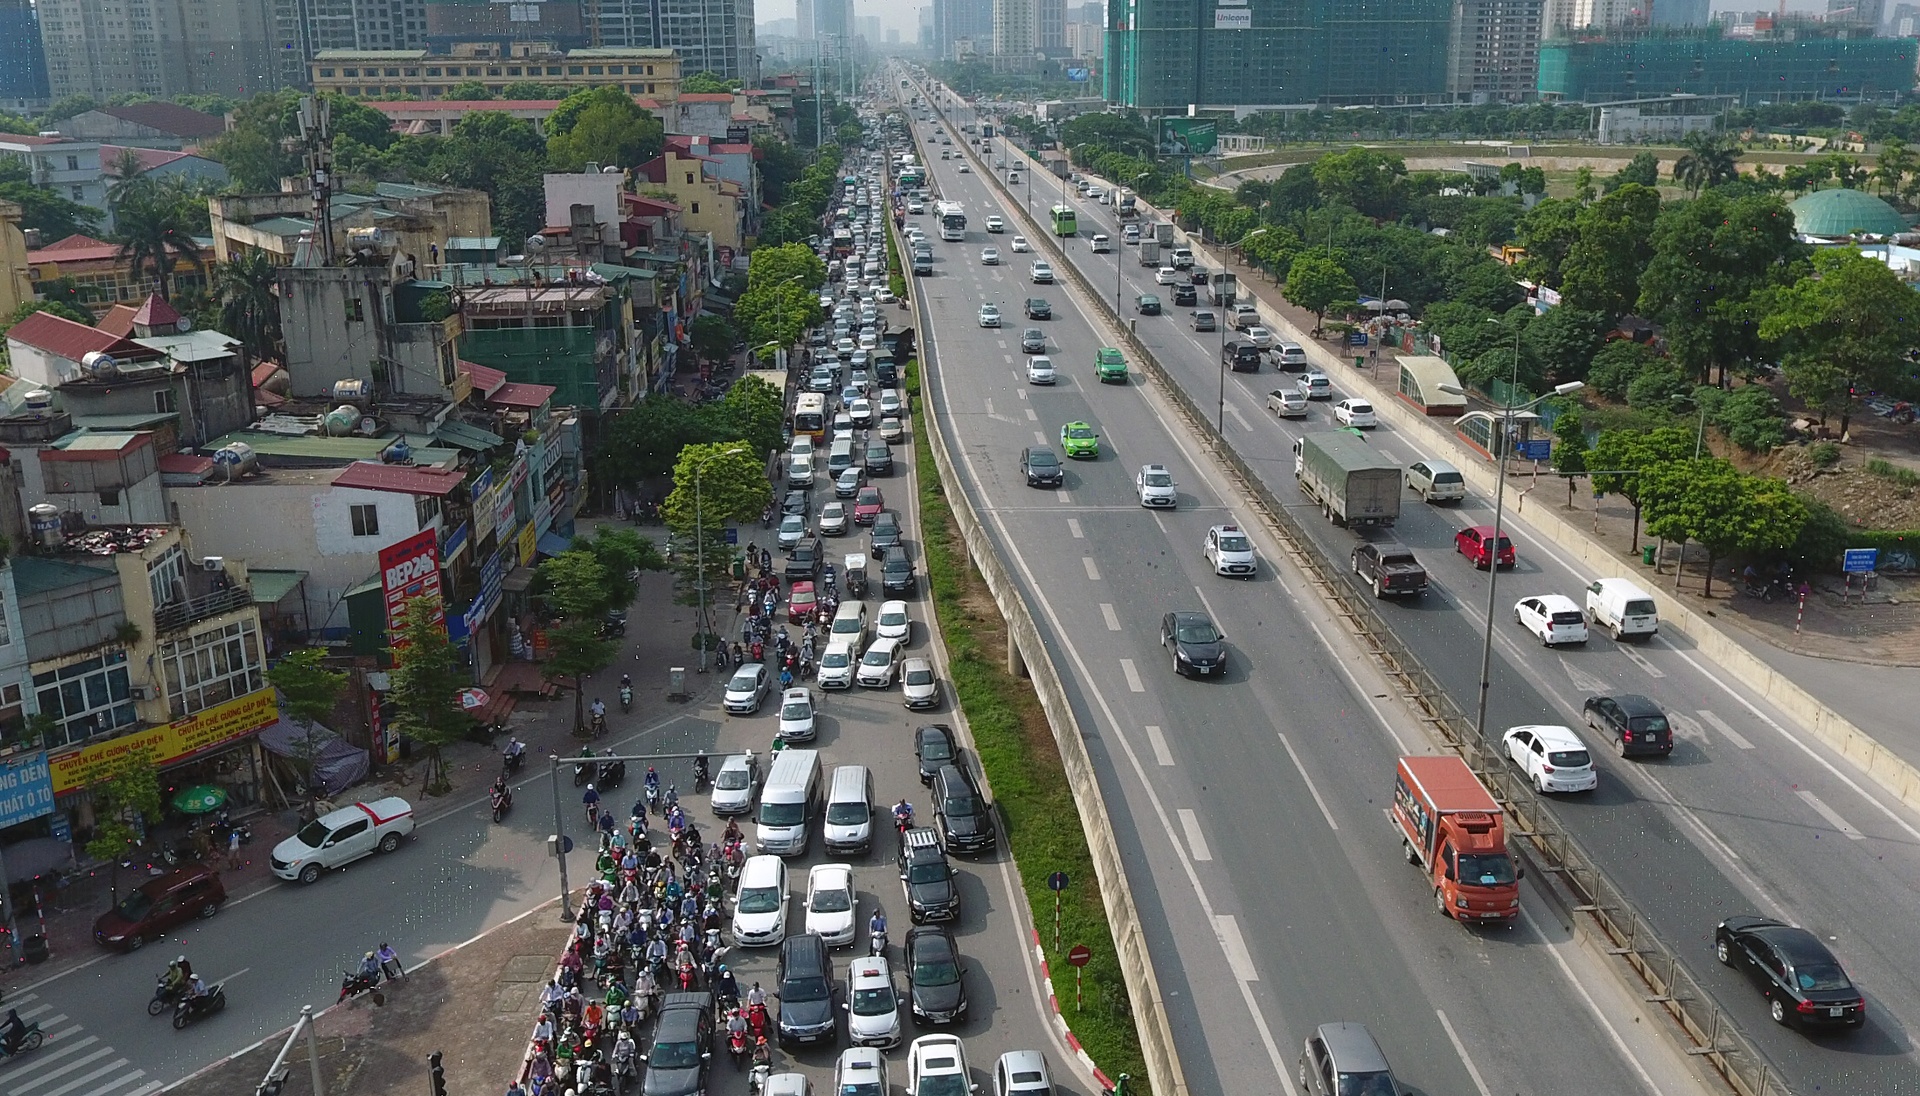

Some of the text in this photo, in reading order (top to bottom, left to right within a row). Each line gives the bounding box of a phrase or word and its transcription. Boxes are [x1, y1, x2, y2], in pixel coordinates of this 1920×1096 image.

[1217, 13, 1249, 21] Unicons
[543, 440, 561, 470] TOTO
[178, 720, 204, 737] CHUYÊN
[206, 714, 219, 726] CHẾ
[220, 708, 241, 721] GƯƠNG
[21, 763, 47, 784] ĐÈN
[59, 756, 89, 771] CHUYÊN
[28, 790, 35, 807] Ô
[37, 785, 51, 804] TÔ
